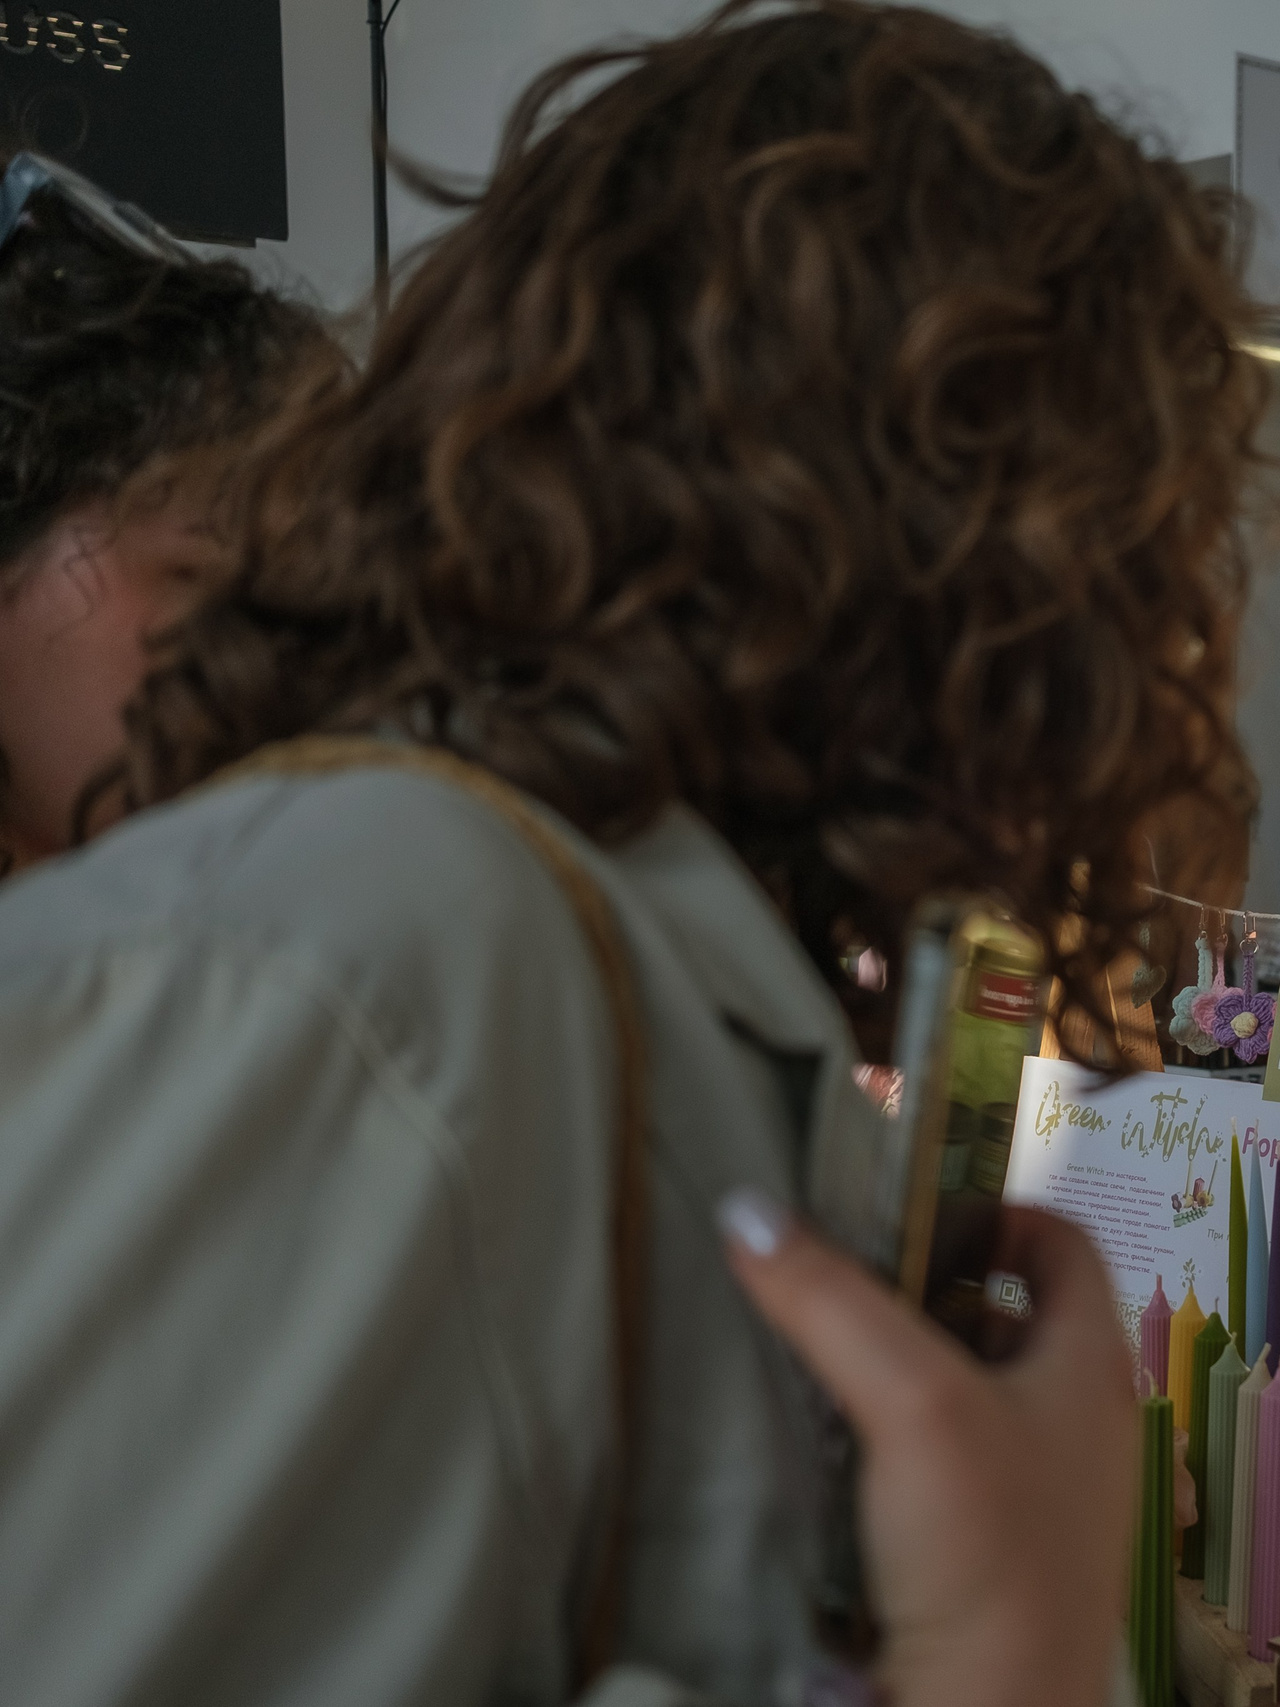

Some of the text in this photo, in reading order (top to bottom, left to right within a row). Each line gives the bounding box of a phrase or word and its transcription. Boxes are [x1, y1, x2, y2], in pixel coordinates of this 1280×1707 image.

[1035, 1080, 1112, 1150] Green
[1067, 1162, 1085, 1173] Green
[1086, 1165, 1105, 1176] Witch
[1048, 1173, 1058, 1181] где
[1128, 1186, 1166, 1198] подсвечники
[1122, 1218, 1142, 1228] городе
[1109, 1228, 1123, 1237] духу
[1207, 1228, 1225, 1242] При
[1130, 1242, 1153, 1251] своими
[1104, 1249, 1130, 1260] смотреть
